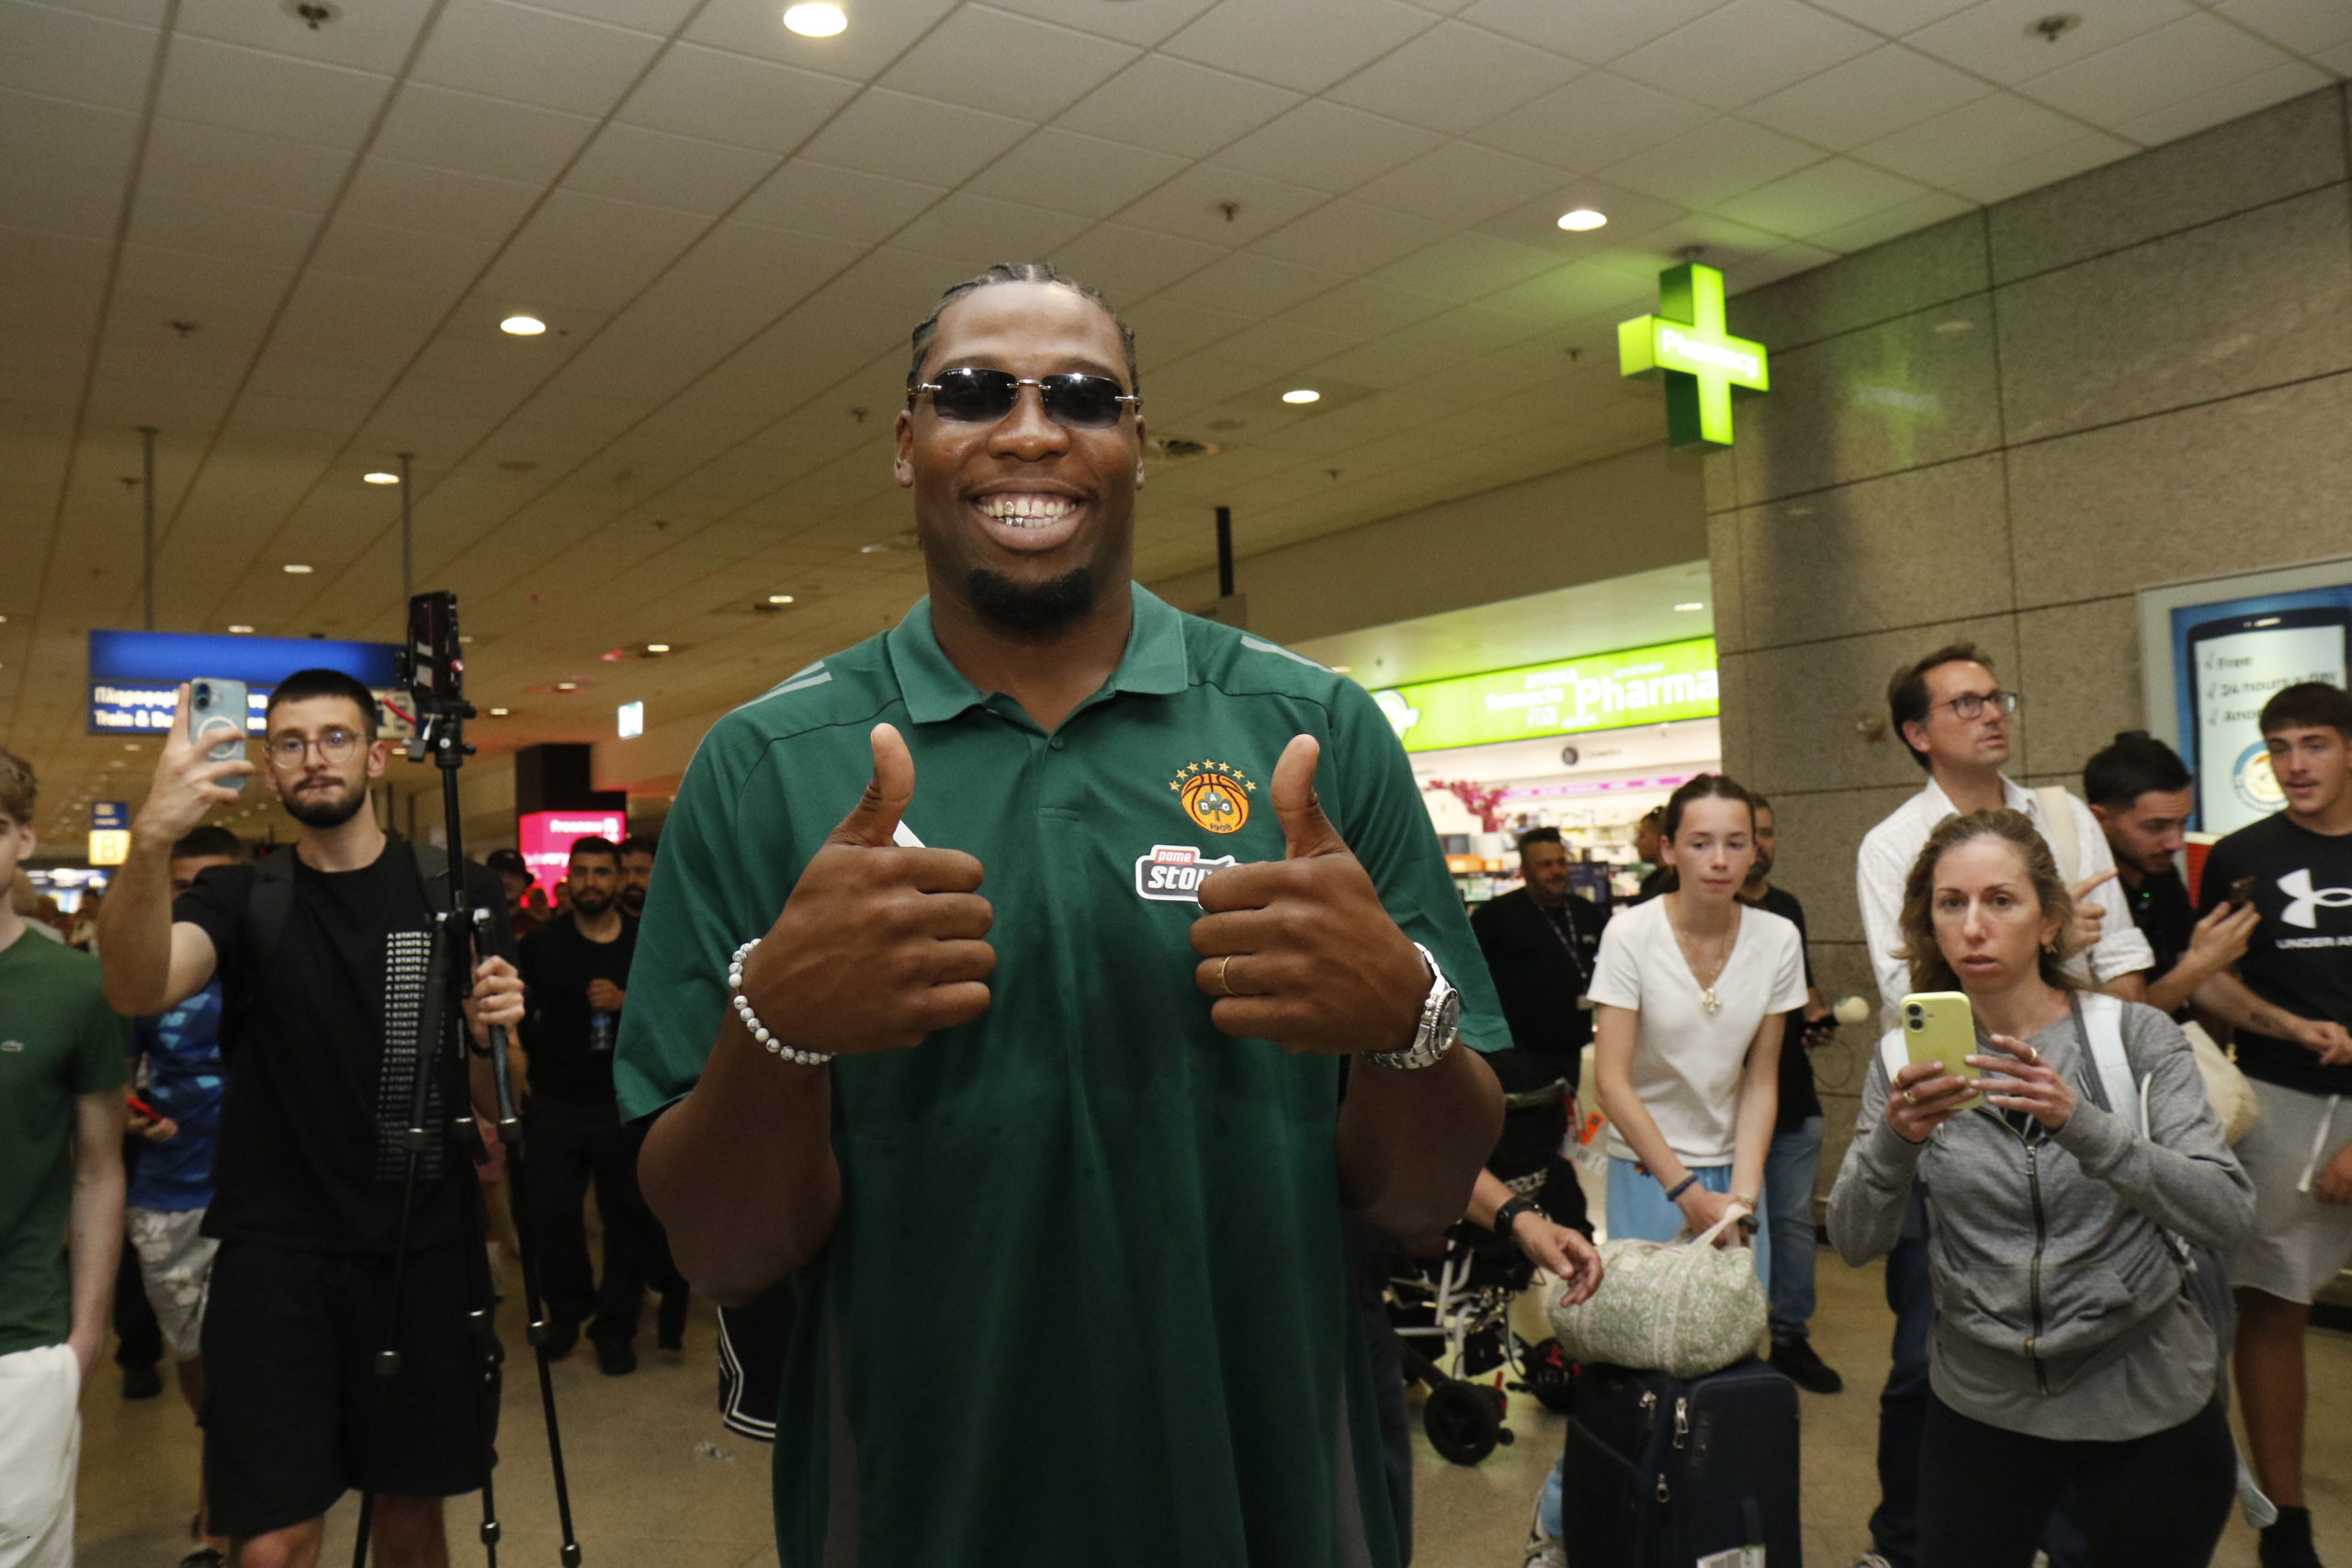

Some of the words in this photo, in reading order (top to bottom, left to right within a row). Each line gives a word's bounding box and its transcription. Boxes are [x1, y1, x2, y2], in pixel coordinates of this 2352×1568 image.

[135, 710, 150, 728] &
[1157, 851, 1193, 863] pame
[2275, 937, 2335, 949] UNDER
[2337, 935, 2352, 947] A
